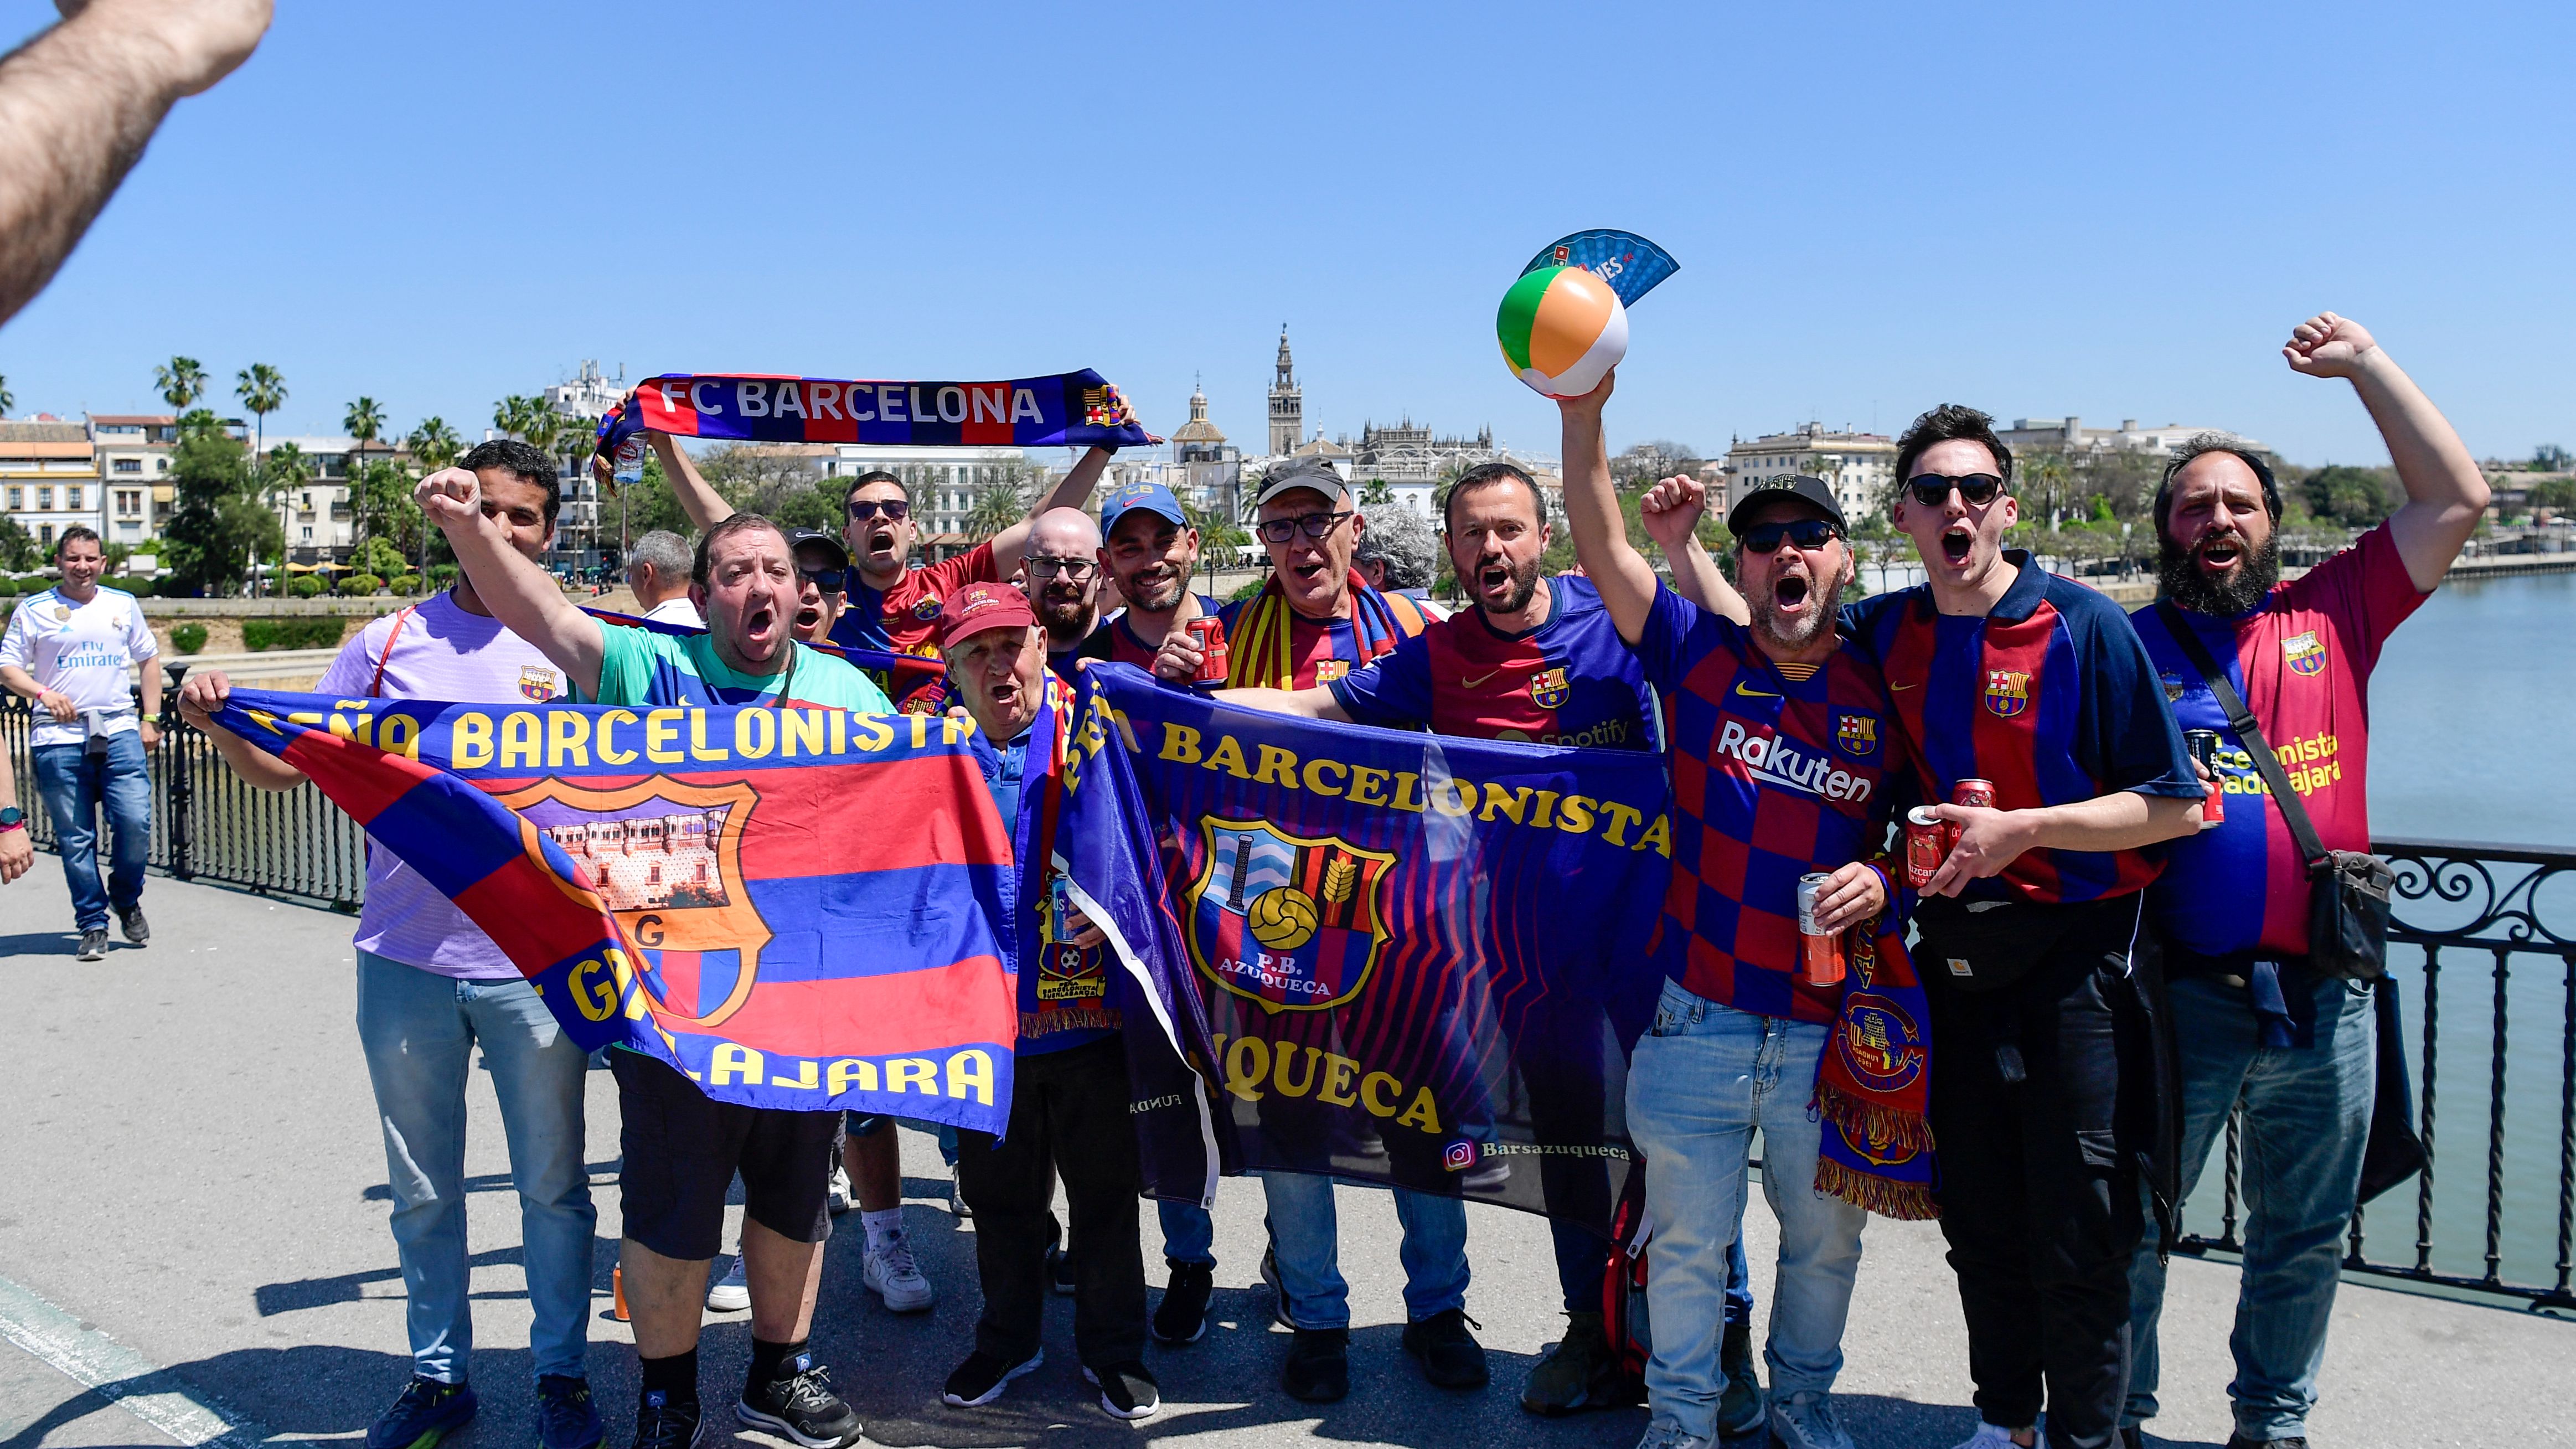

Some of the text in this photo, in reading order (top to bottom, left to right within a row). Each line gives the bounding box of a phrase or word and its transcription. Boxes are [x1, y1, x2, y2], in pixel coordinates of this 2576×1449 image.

[662, 381, 1044, 424] FC BARCELONA
[58, 653, 122, 668] Emirate
[82, 641, 104, 652] Fly
[1717, 720, 1871, 802] Rakuten
[1157, 721, 1671, 858] BARCELONISTA
[1219, 958, 1331, 996] AZUQUECA
[1257, 952, 1303, 975] P.B.
[1481, 1142, 1630, 1161] Barsazuqueca
